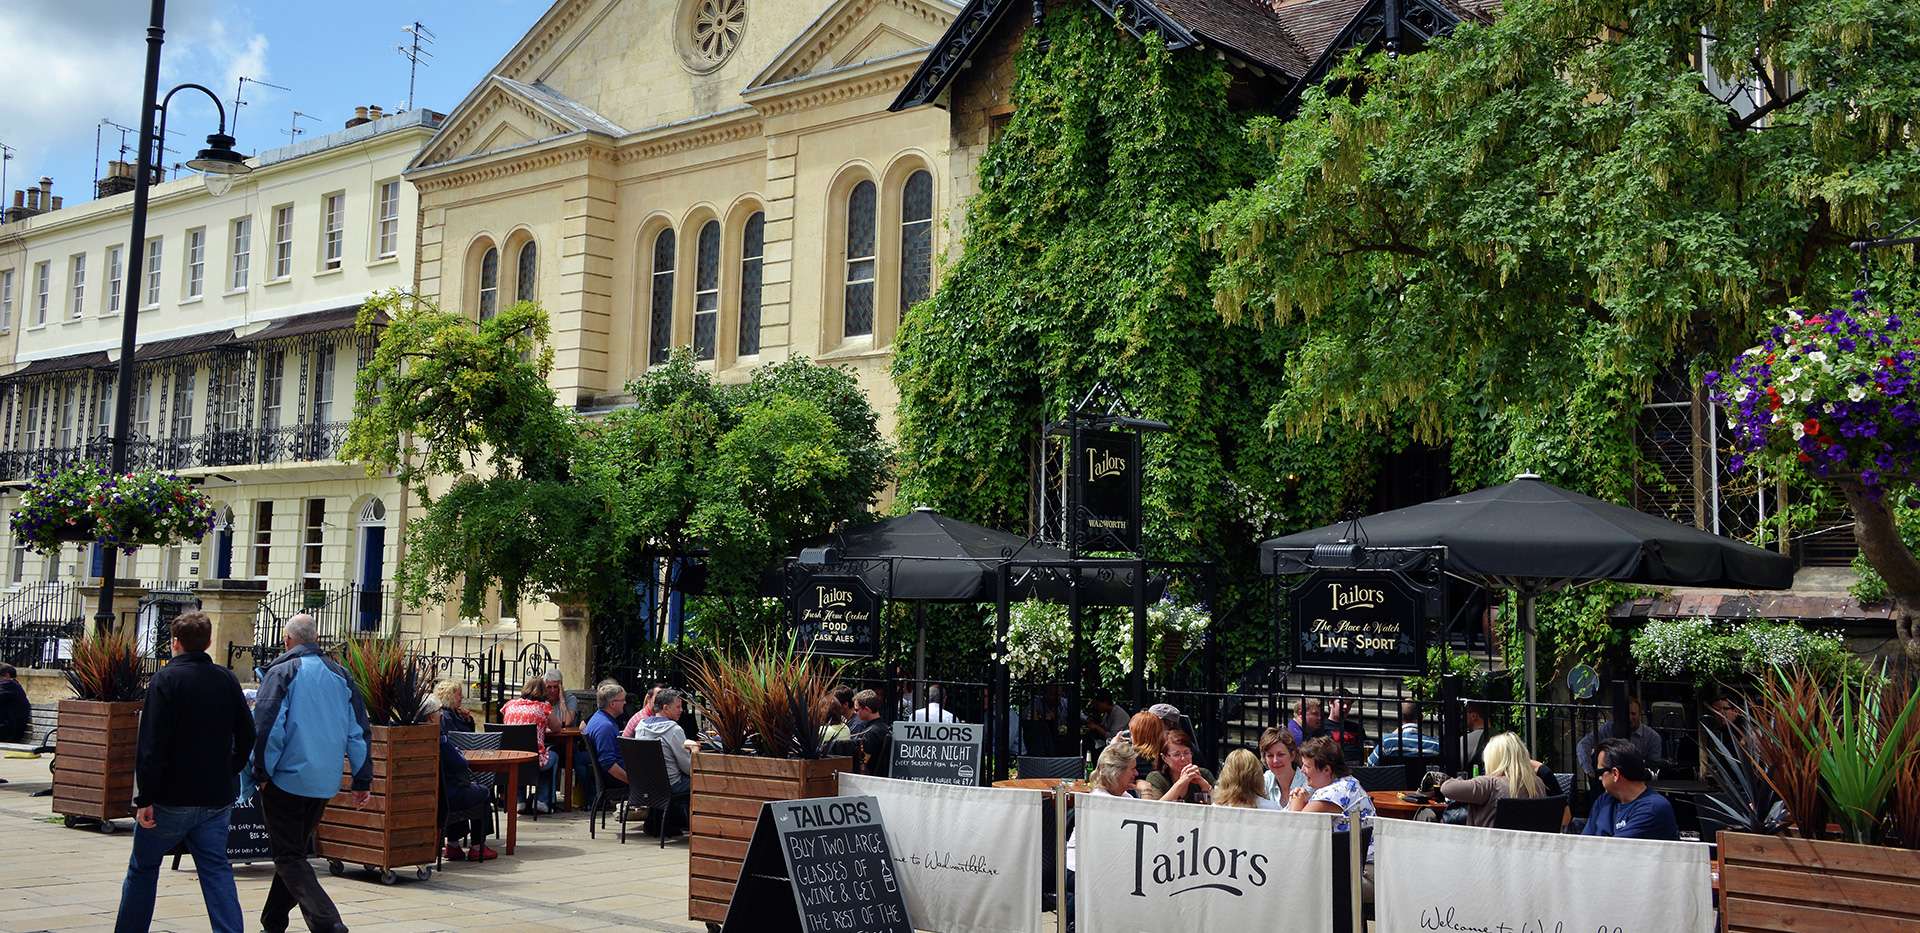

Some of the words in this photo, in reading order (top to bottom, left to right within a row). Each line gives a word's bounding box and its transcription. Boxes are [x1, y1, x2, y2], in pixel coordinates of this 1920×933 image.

[1086, 448, 1126, 481] Tailors
[816, 586, 853, 608] Tailors
[1327, 583, 1385, 610] Tailors
[802, 609, 822, 621] Fresh
[822, 610, 843, 621] Home
[845, 611, 870, 622] Cooked
[822, 622, 848, 631] FOOD
[1310, 618, 1333, 633] The
[1333, 620, 1361, 634] Place
[1362, 622, 1372, 632] to
[1372, 621, 1400, 634] Watch
[814, 633, 833, 641] CASK
[835, 635, 855, 643] ALES
[904, 725, 973, 741] TAILORS
[900, 743, 938, 760] BURGER
[941, 745, 972, 761] NIGHT
[788, 801, 872, 829] TAILORS
[790, 836, 815, 860] BUY
[818, 835, 845, 855] TWO
[845, 833, 884, 854] LARGE
[1121, 819, 1268, 897] Tailors
[796, 861, 847, 886] GLASSES
[854, 859, 868, 877] OF
[801, 885, 837, 906] WINE
[840, 883, 851, 902] &
[853, 880, 877, 900] GET
[807, 912, 831, 931] THE
[832, 909, 857, 929] REST
[861, 905, 874, 924] OF
[876, 904, 901, 924] THE
[1420, 906, 1490, 933] Welcome
